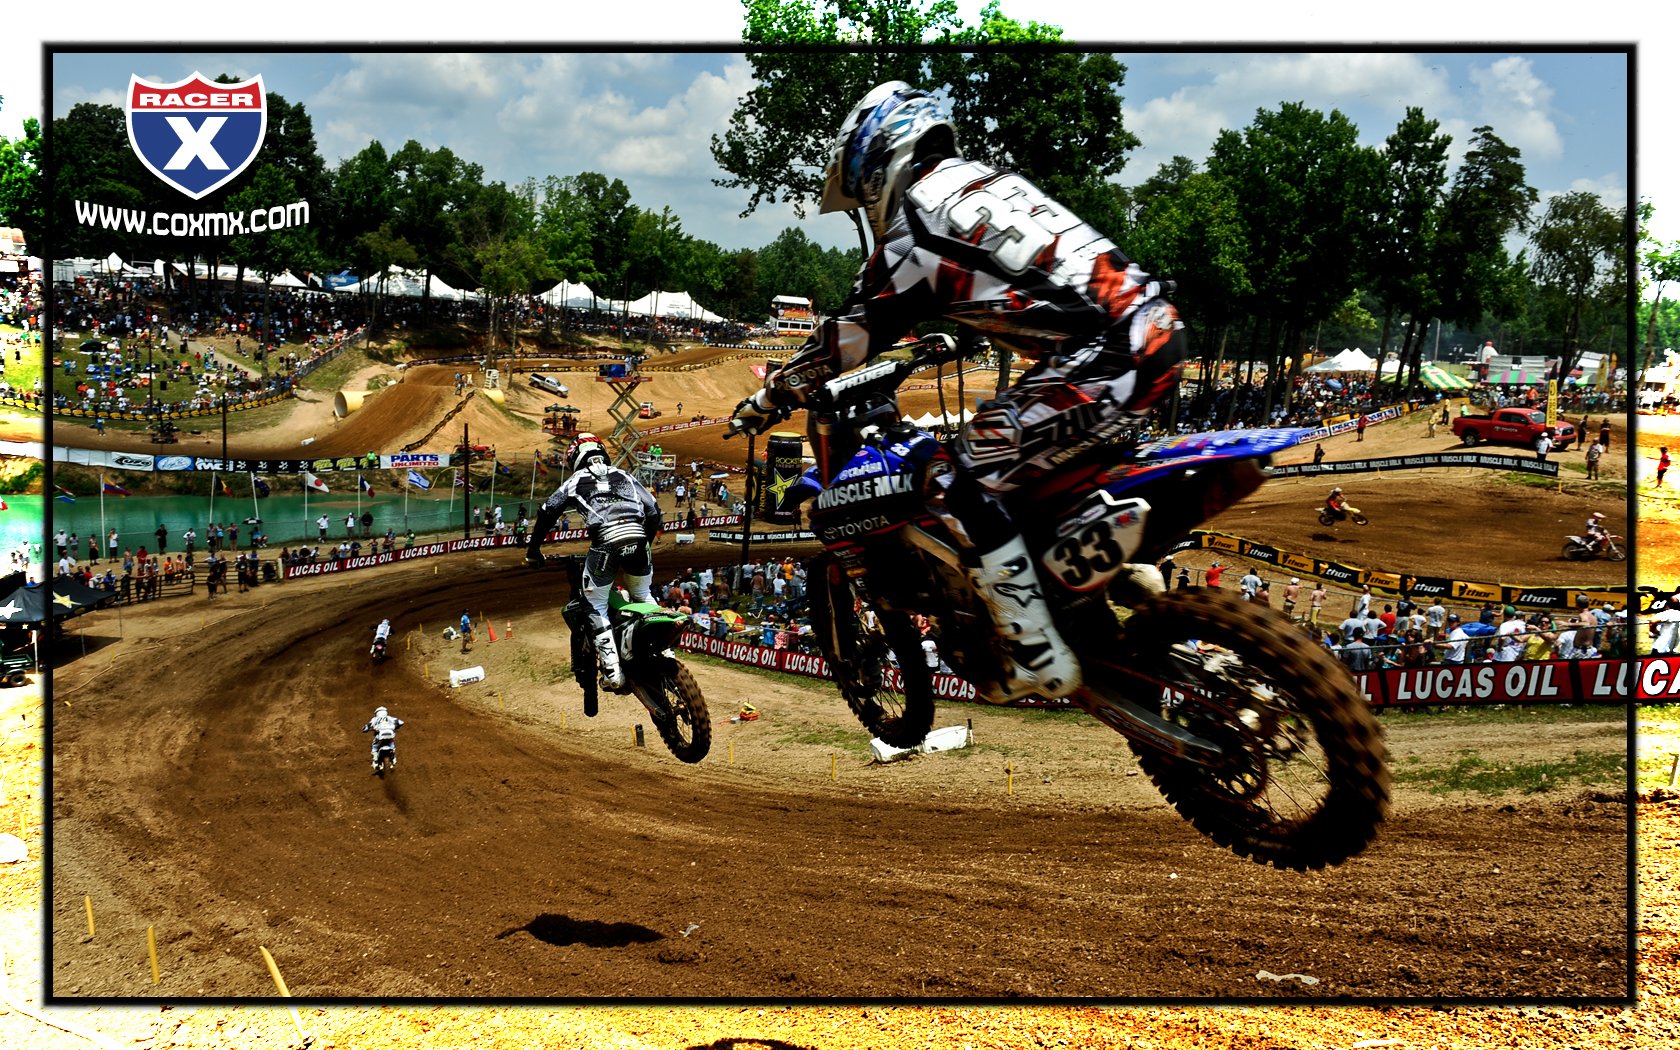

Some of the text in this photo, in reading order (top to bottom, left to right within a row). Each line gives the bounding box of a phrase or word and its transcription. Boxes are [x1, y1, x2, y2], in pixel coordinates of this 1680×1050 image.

[391, 454, 439, 462] PARTS
[775, 457, 801, 465] ROCKST
[817, 473, 914, 509] MUSCLE MILK
[662, 521, 679, 531] CAS
[700, 516, 739, 527] LUCAS OIL
[837, 515, 890, 537] TOYOTA
[502, 534, 532, 546] LUCS
[554, 529, 582, 541] LUCAS
[452, 537, 495, 551] LUCAS OIL
[400, 544, 444, 560] LUCAS OIL
[1053, 521, 1125, 587] 33
[1249, 548, 1273, 559] thor
[345, 552, 394, 569] LUCAS OIL
[289, 561, 339, 577] LUCAS OIL
[1325, 568, 1352, 579] thor
[1369, 575, 1395, 586] thor
[1413, 583, 1445, 594] thor
[1465, 588, 1495, 599] thor
[1520, 594, 1558, 604] thor
[679, 631, 726, 657] LUCAS OIL
[725, 643, 778, 667] LUCAS OIL
[784, 653, 820, 675] LUCAS
[1397, 664, 1559, 700] LUCAS OIL
[1592, 659, 1680, 696] LUCA
[931, 676, 977, 700] LUCAS
